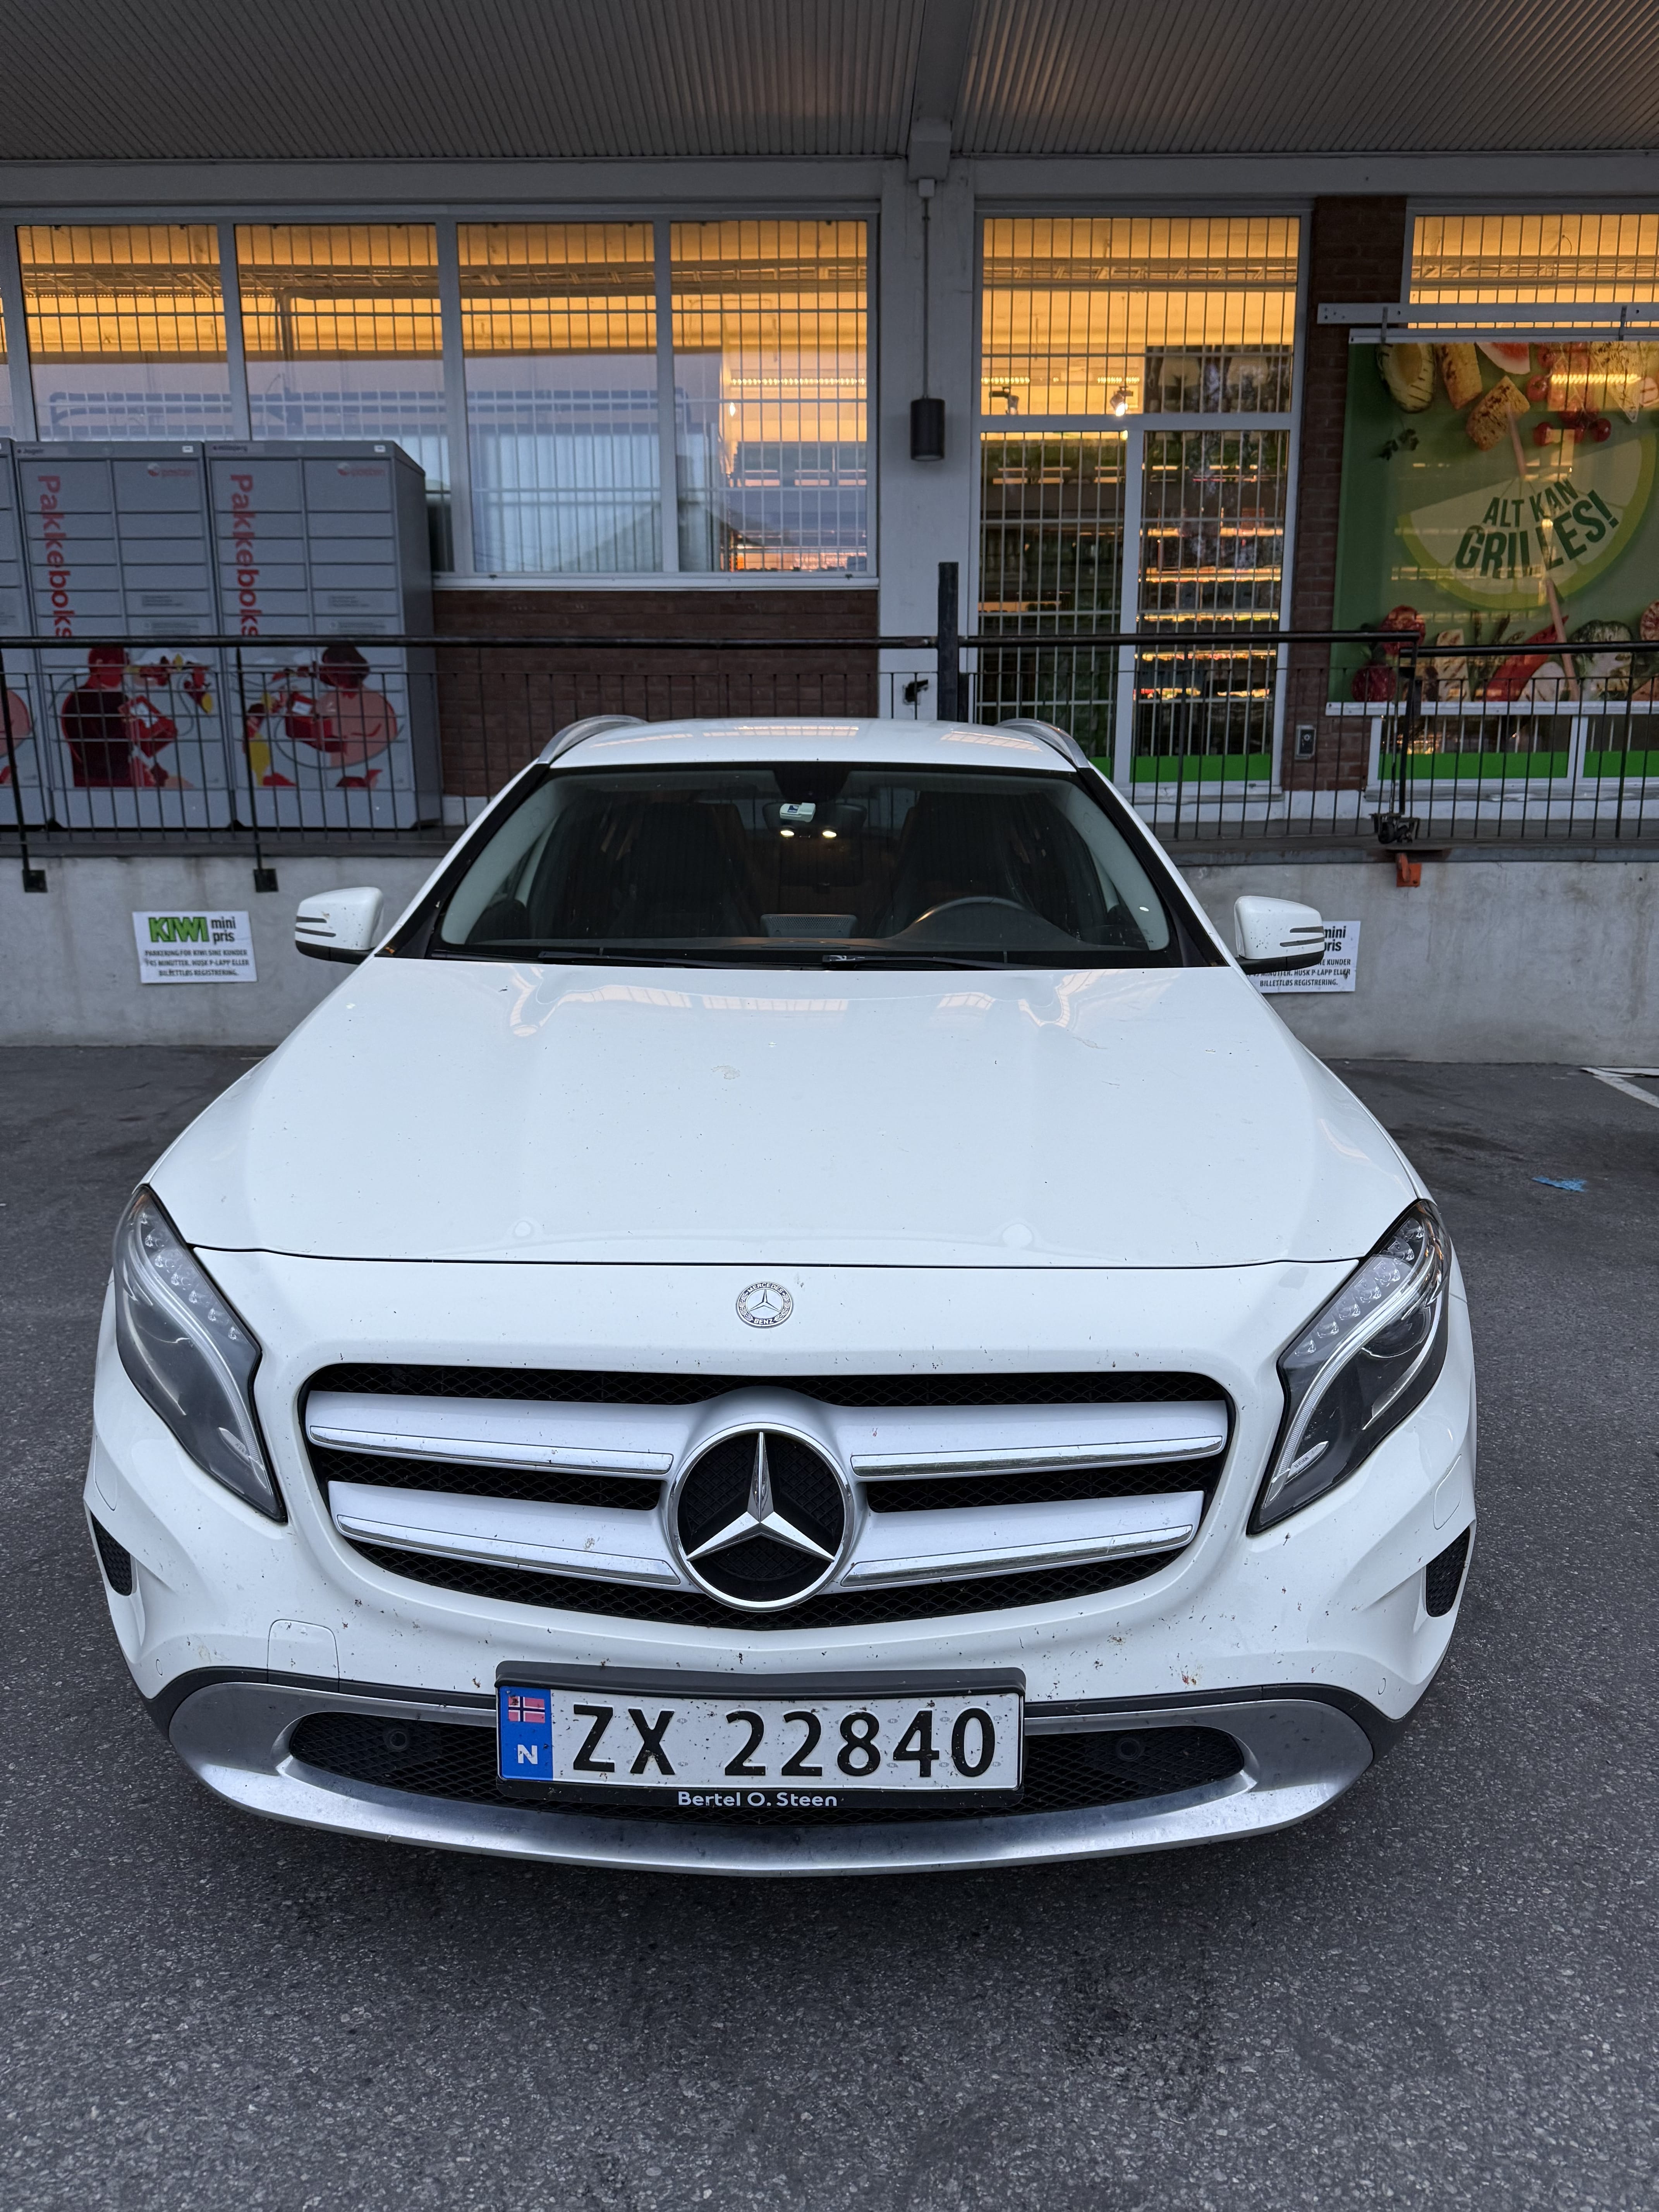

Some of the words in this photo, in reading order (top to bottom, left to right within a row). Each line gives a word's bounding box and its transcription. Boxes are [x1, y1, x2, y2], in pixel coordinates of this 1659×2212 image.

[1482, 497, 1525, 527] ALT
[1529, 479, 1579, 522] KAN
[1455, 489, 1620, 579] GRILLES!
[38, 476, 75, 637] Pakkeboks
[230, 475, 262, 635] Pakkeboks
[148, 917, 210, 942] KIWI
[211, 916, 236, 929] mini
[213, 929, 235, 945] pris
[747, 1283, 784, 1293] MERCEDES
[573, 1704, 675, 1775] ZX
[724, 1707, 995, 1778] 22840
[517, 1744, 538, 1764] N
[678, 1791, 740, 1806] Bertel
[747, 1792, 771, 1806] O.
[776, 1792, 837, 1806] Steen
